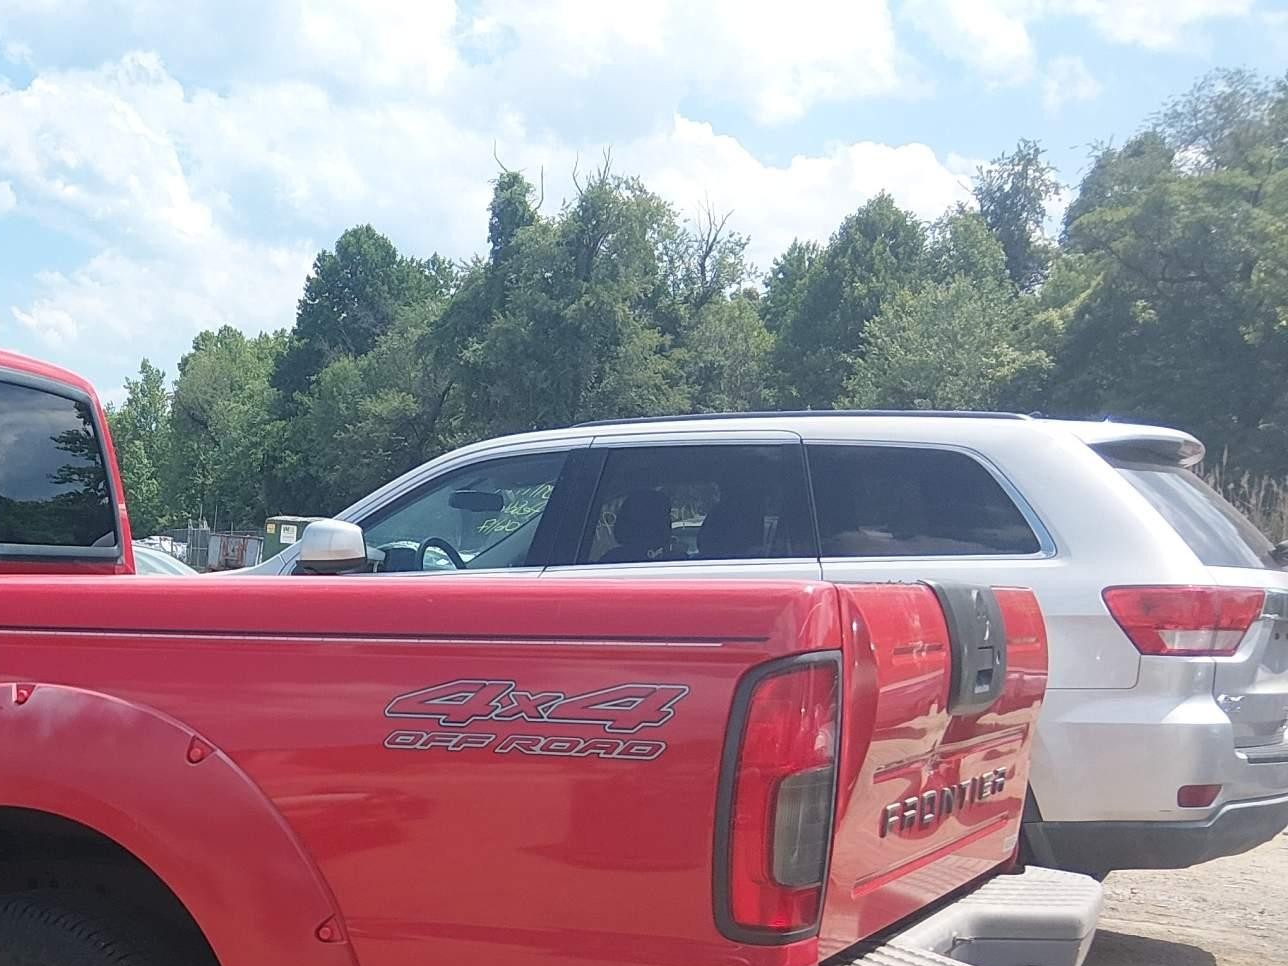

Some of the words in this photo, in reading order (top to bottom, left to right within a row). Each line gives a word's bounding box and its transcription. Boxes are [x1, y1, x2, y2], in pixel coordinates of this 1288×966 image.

[384, 679, 689, 733] 4x4
[383, 730, 497, 751] OFF
[494, 735, 667, 761] ROAD
[879, 766, 1008, 839] FRONTIER
